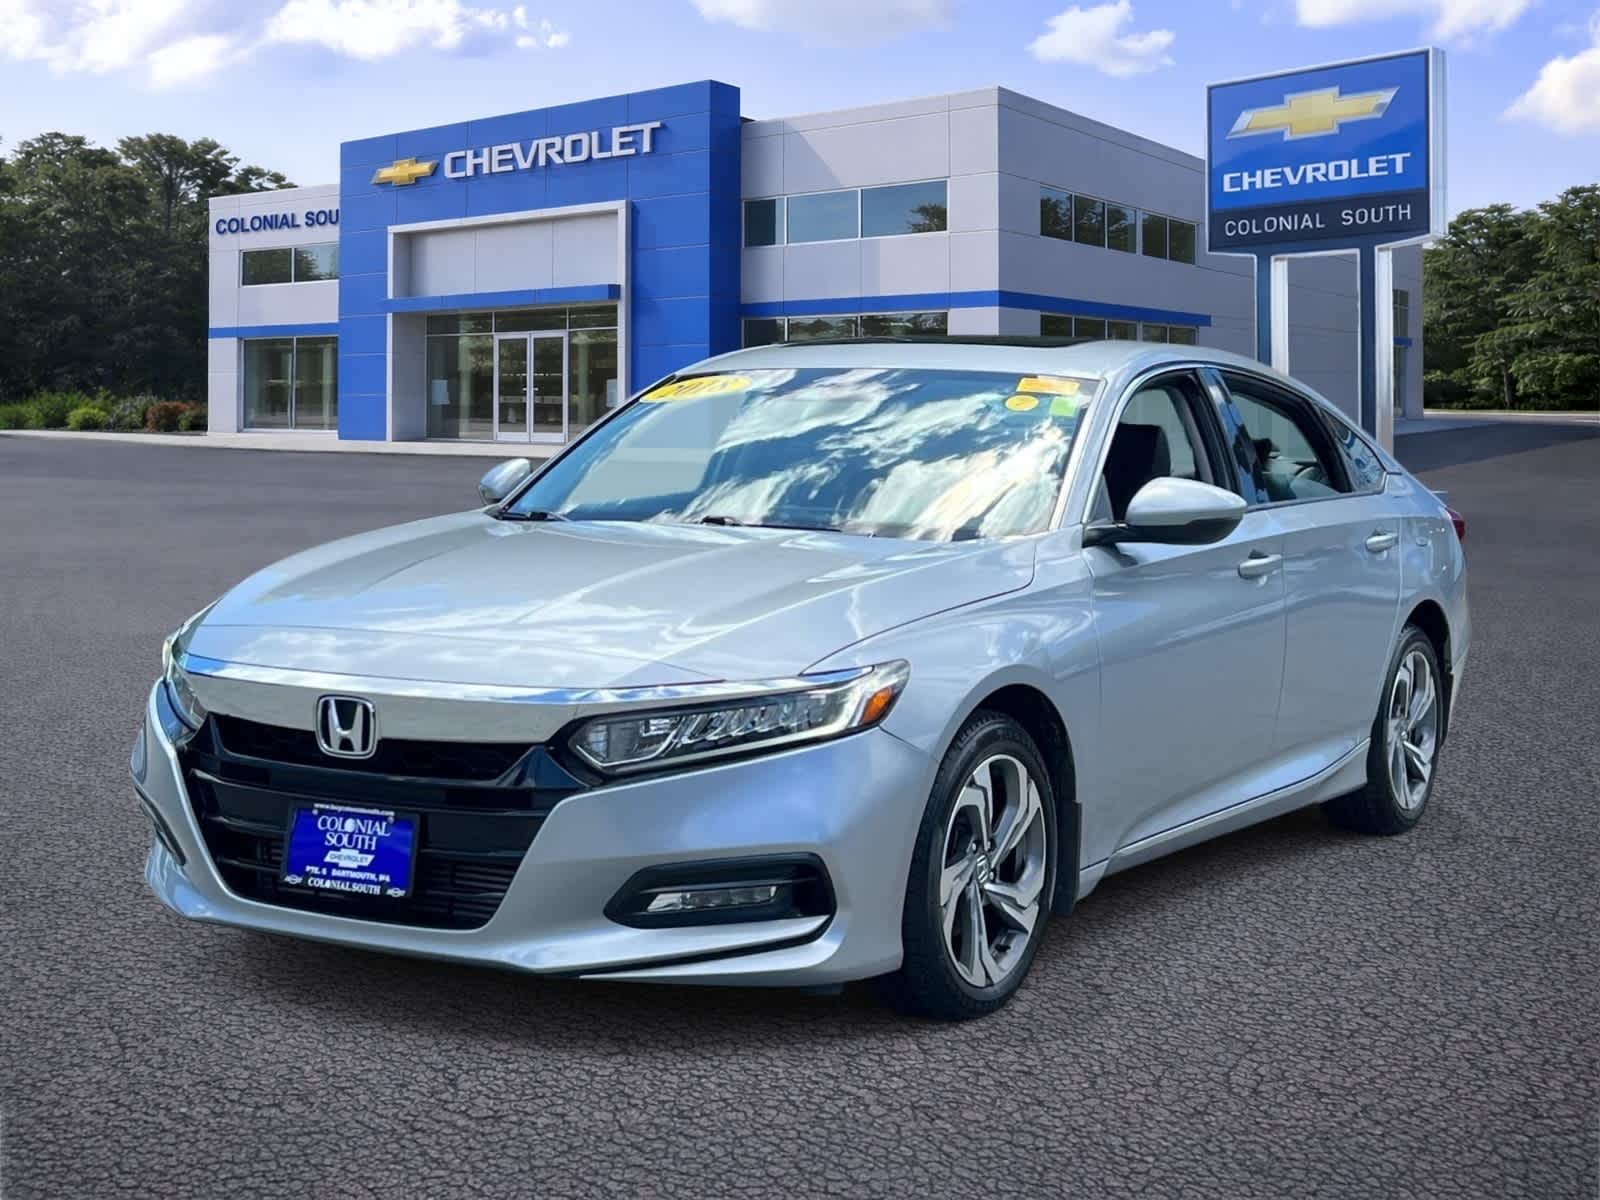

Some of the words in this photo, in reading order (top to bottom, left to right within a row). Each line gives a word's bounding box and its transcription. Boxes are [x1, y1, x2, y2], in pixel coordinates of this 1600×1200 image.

[444, 120, 662, 178] CHEVROLET
[1222, 152, 1411, 193] CHEVROLET
[215, 213, 301, 235] COLONIAL
[305, 208, 340, 227] SOU
[1224, 212, 1325, 237] COLONIAL
[1341, 203, 1412, 226] SOUTH
[317, 815, 391, 837] COLONIAL
[324, 832, 377, 850] SOUTH
[329, 853, 369, 863] CHEVROLET
